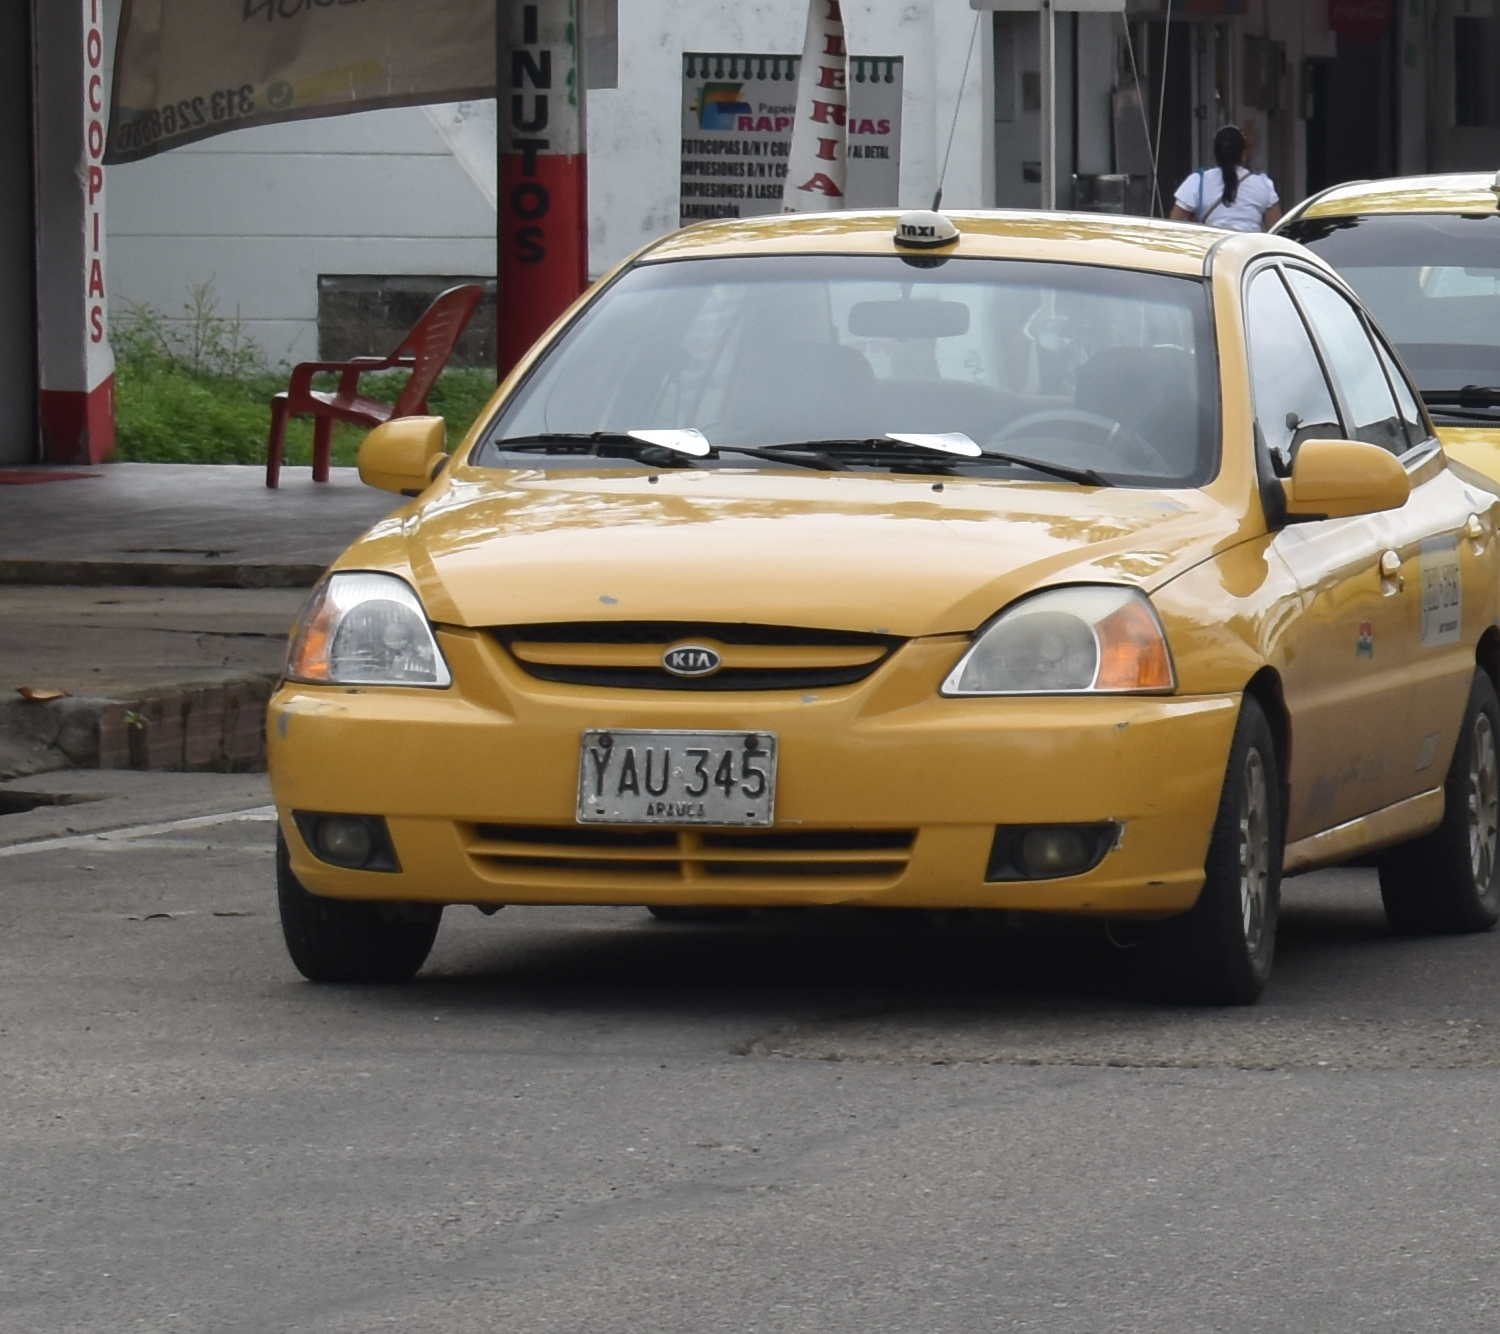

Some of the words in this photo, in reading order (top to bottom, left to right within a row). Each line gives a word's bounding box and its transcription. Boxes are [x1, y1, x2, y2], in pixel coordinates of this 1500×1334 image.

[681, 139, 741, 155] FOTOCOPIAS
[864, 146, 890, 159] DETAL
[681, 161, 745, 178] IMPRESIONES
[681, 182, 745, 199] IMPRESIONES
[746, 183, 753, 198] A
[754, 183, 784, 199] LASER
[901, 223, 936, 237] TAXI
[672, 652, 712, 668] KIA
[590, 746, 671, 797] YAU
[684, 747, 770, 800] 345
[646, 801, 706, 818] ARAUCA
